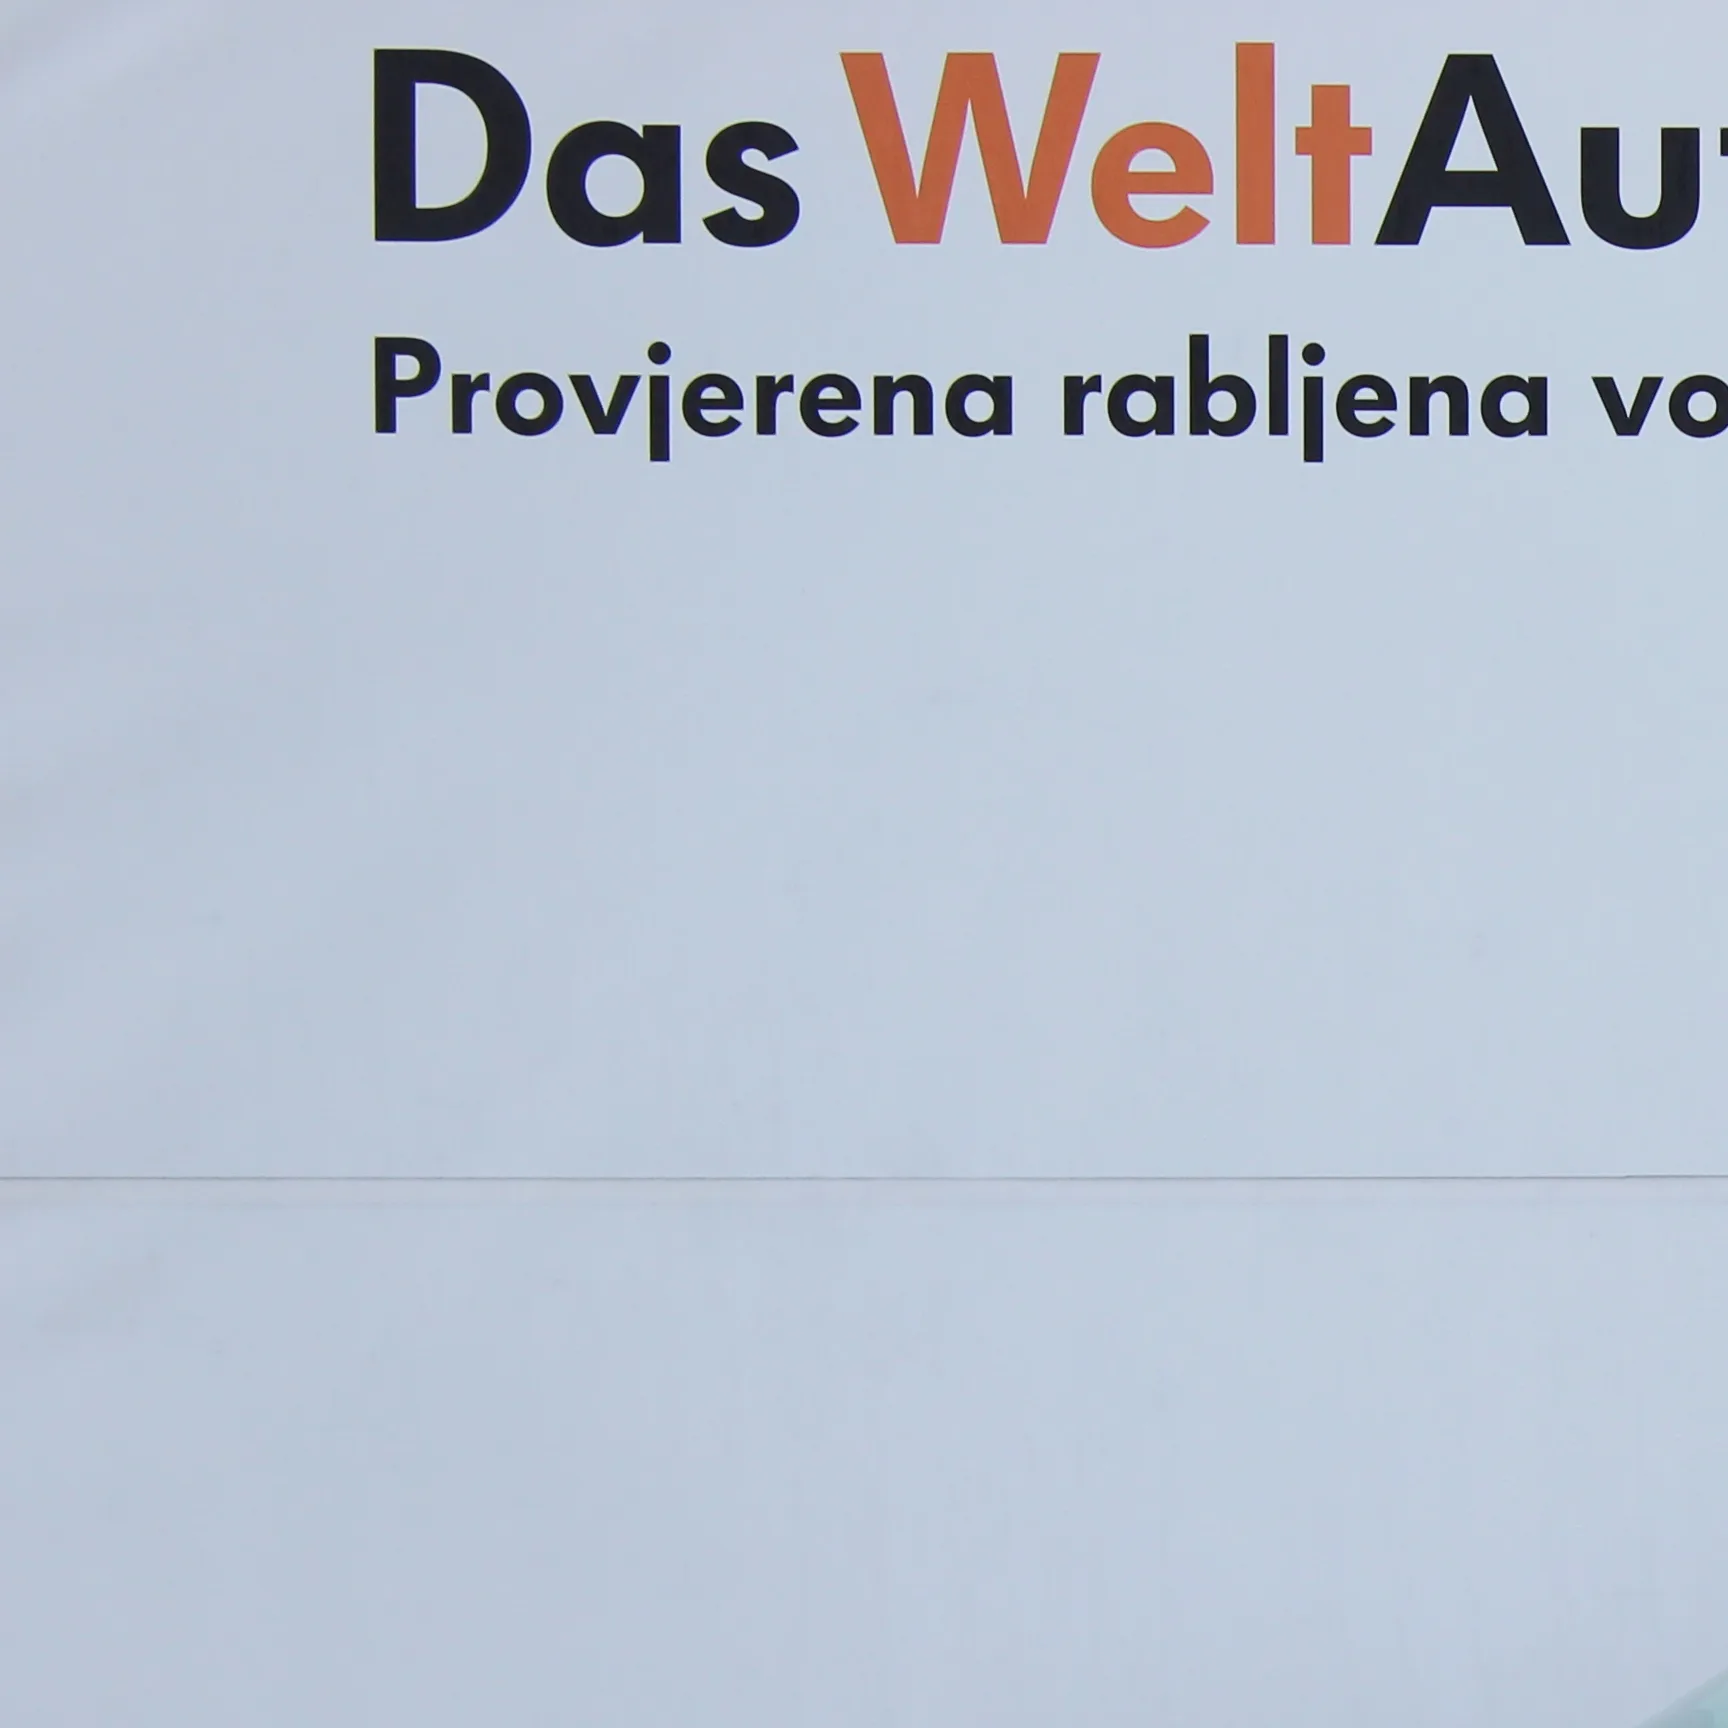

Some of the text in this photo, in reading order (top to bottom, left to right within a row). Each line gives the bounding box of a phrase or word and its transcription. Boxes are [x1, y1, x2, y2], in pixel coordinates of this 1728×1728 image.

[373, 47, 801, 249] Das
[374, 336, 1013, 463] Provjerena
[1063, 333, 1548, 464] rabljena
